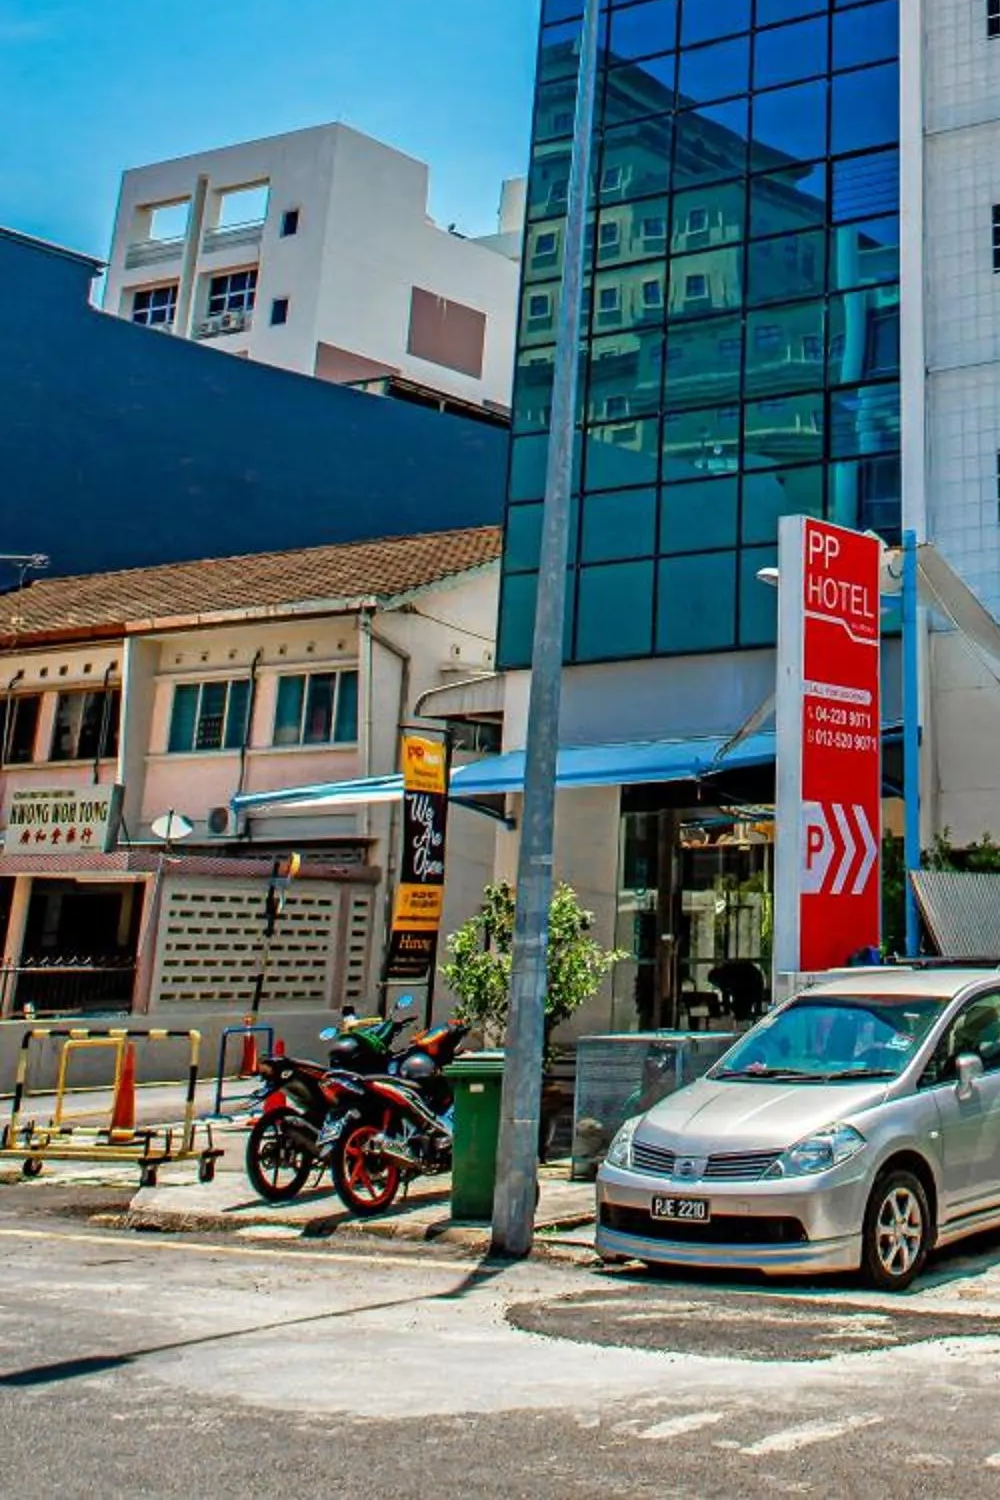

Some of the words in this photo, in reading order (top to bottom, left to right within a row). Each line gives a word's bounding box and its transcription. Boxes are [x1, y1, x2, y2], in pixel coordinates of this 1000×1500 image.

[808, 529, 840, 569] PP
[808, 572, 875, 618] HOTEL
[10, 803, 49, 825] KWONG
[405, 793, 434, 822] We
[412, 820, 443, 849] Are
[806, 824, 825, 870] P
[413, 846, 445, 883] Open
[655, 1198, 676, 1216] PJE
[677, 1199, 706, 1219] 2210
